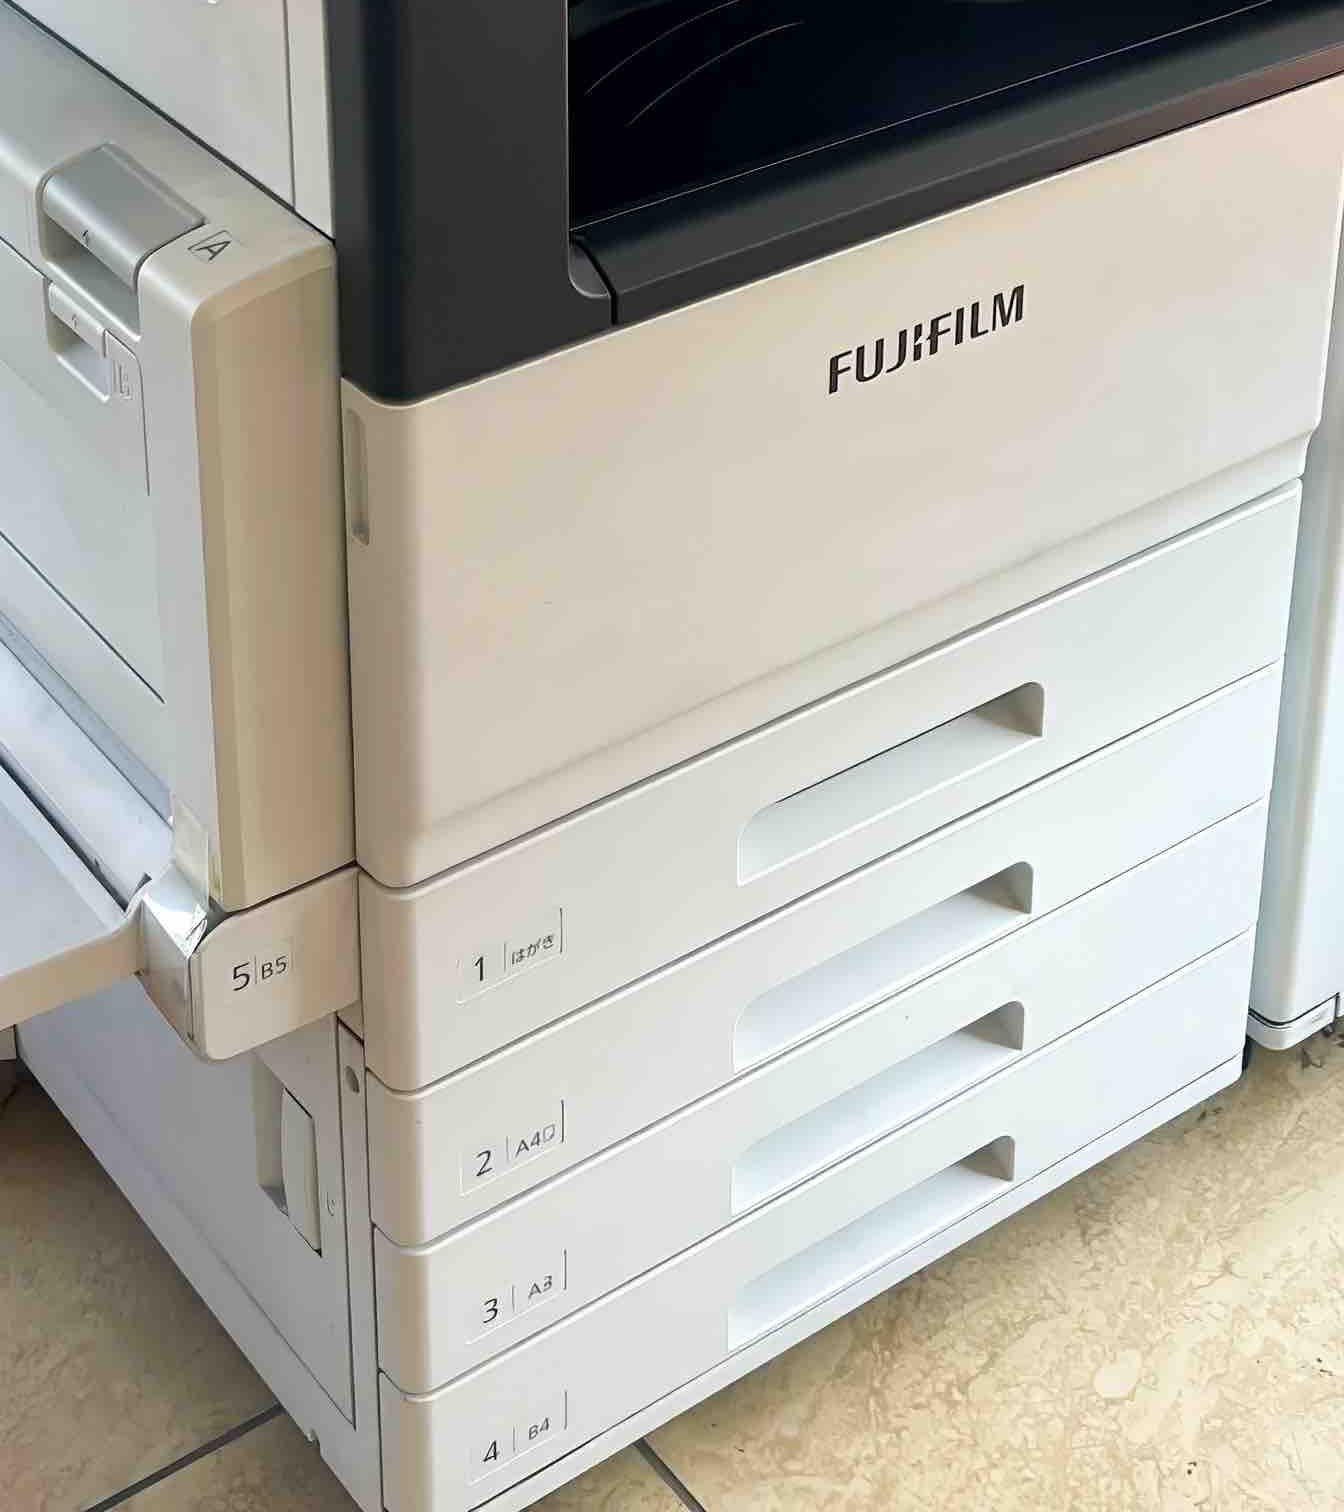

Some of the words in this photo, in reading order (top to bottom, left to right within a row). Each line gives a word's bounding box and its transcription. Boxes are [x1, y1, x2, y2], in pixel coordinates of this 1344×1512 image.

[828, 283, 1026, 395] FUJIFILM
[510, 934, 555, 966] はがき
[232, 963, 251, 992] 5
[261, 955, 288, 981] B5
[476, 1149, 493, 1177] 2
[482, 1297, 499, 1324] 3
[527, 1275, 554, 1299] A3
[483, 1440, 501, 1462] 4
[527, 1417, 552, 1441] B4
